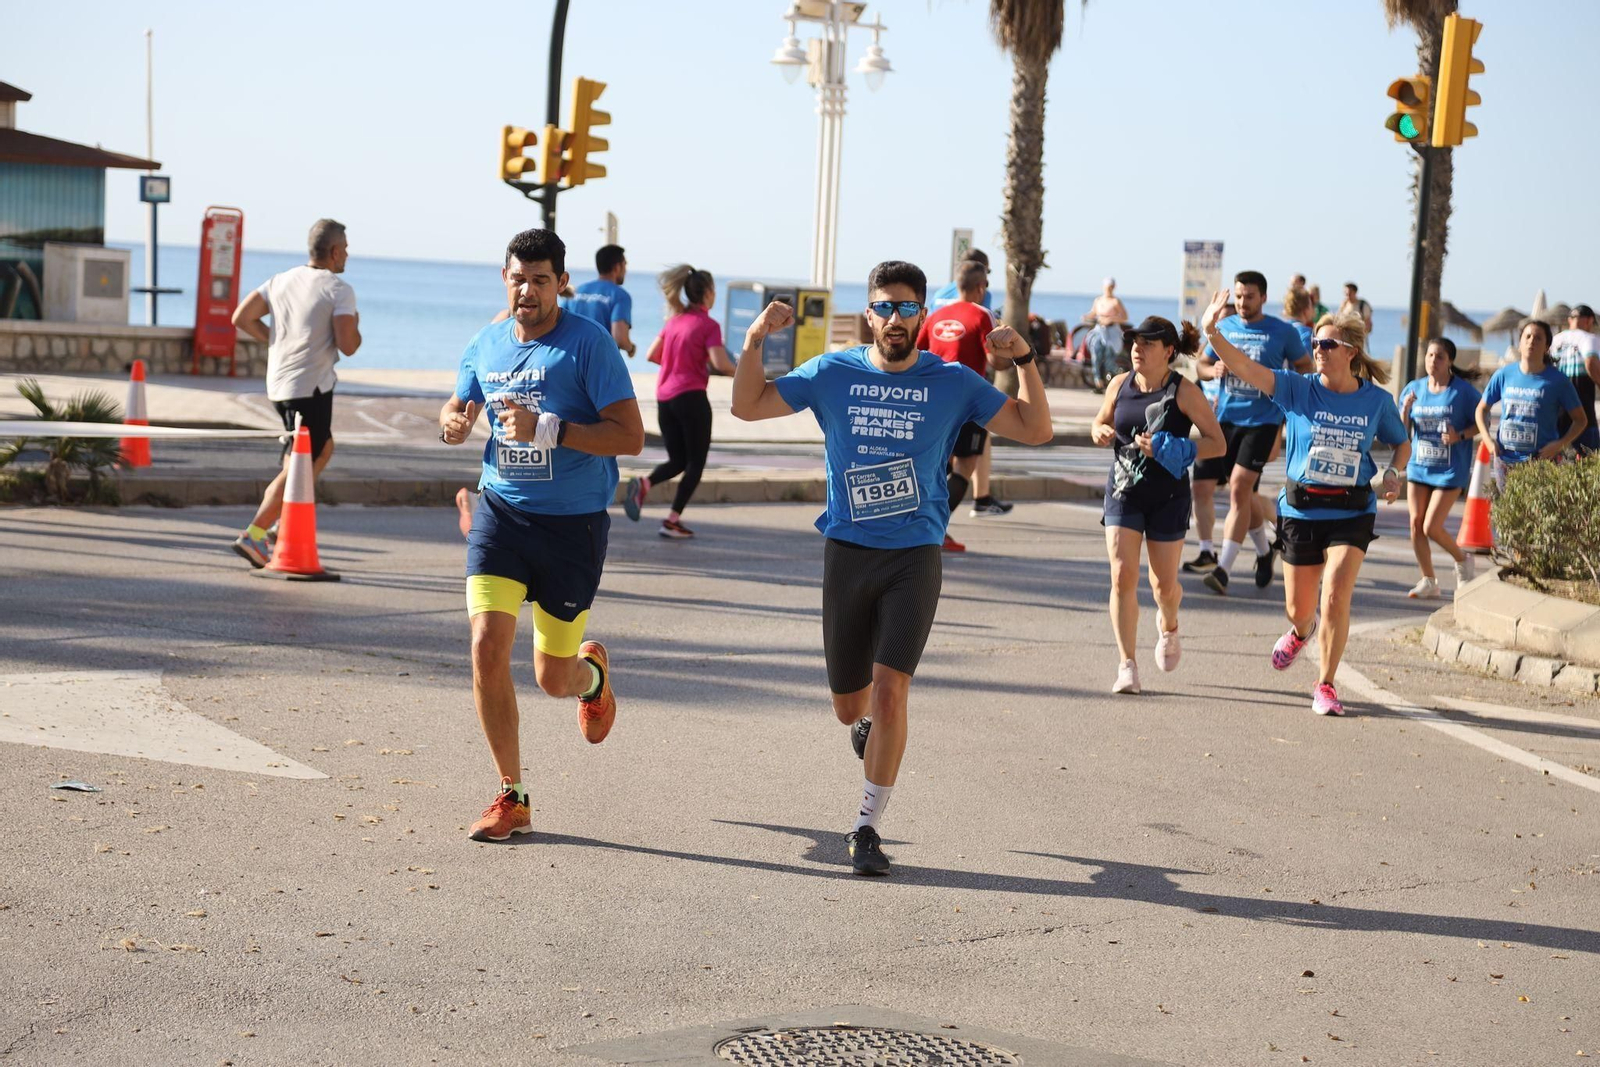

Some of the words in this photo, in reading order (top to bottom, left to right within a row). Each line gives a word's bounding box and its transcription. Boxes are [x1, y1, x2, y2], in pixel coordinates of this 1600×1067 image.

[849, 383, 929, 402] mayoral
[847, 405, 922, 422] RUNNING
[1314, 410, 1368, 427] mayoral
[853, 416, 914, 431] MAKES
[851, 425, 914, 440] FRIENDS
[1310, 424, 1364, 440] RUNNING
[1315, 433, 1359, 446] MAKES
[500, 449, 543, 464] 1620
[1318, 460, 1347, 476] 736
[856, 479, 910, 502] 1984
